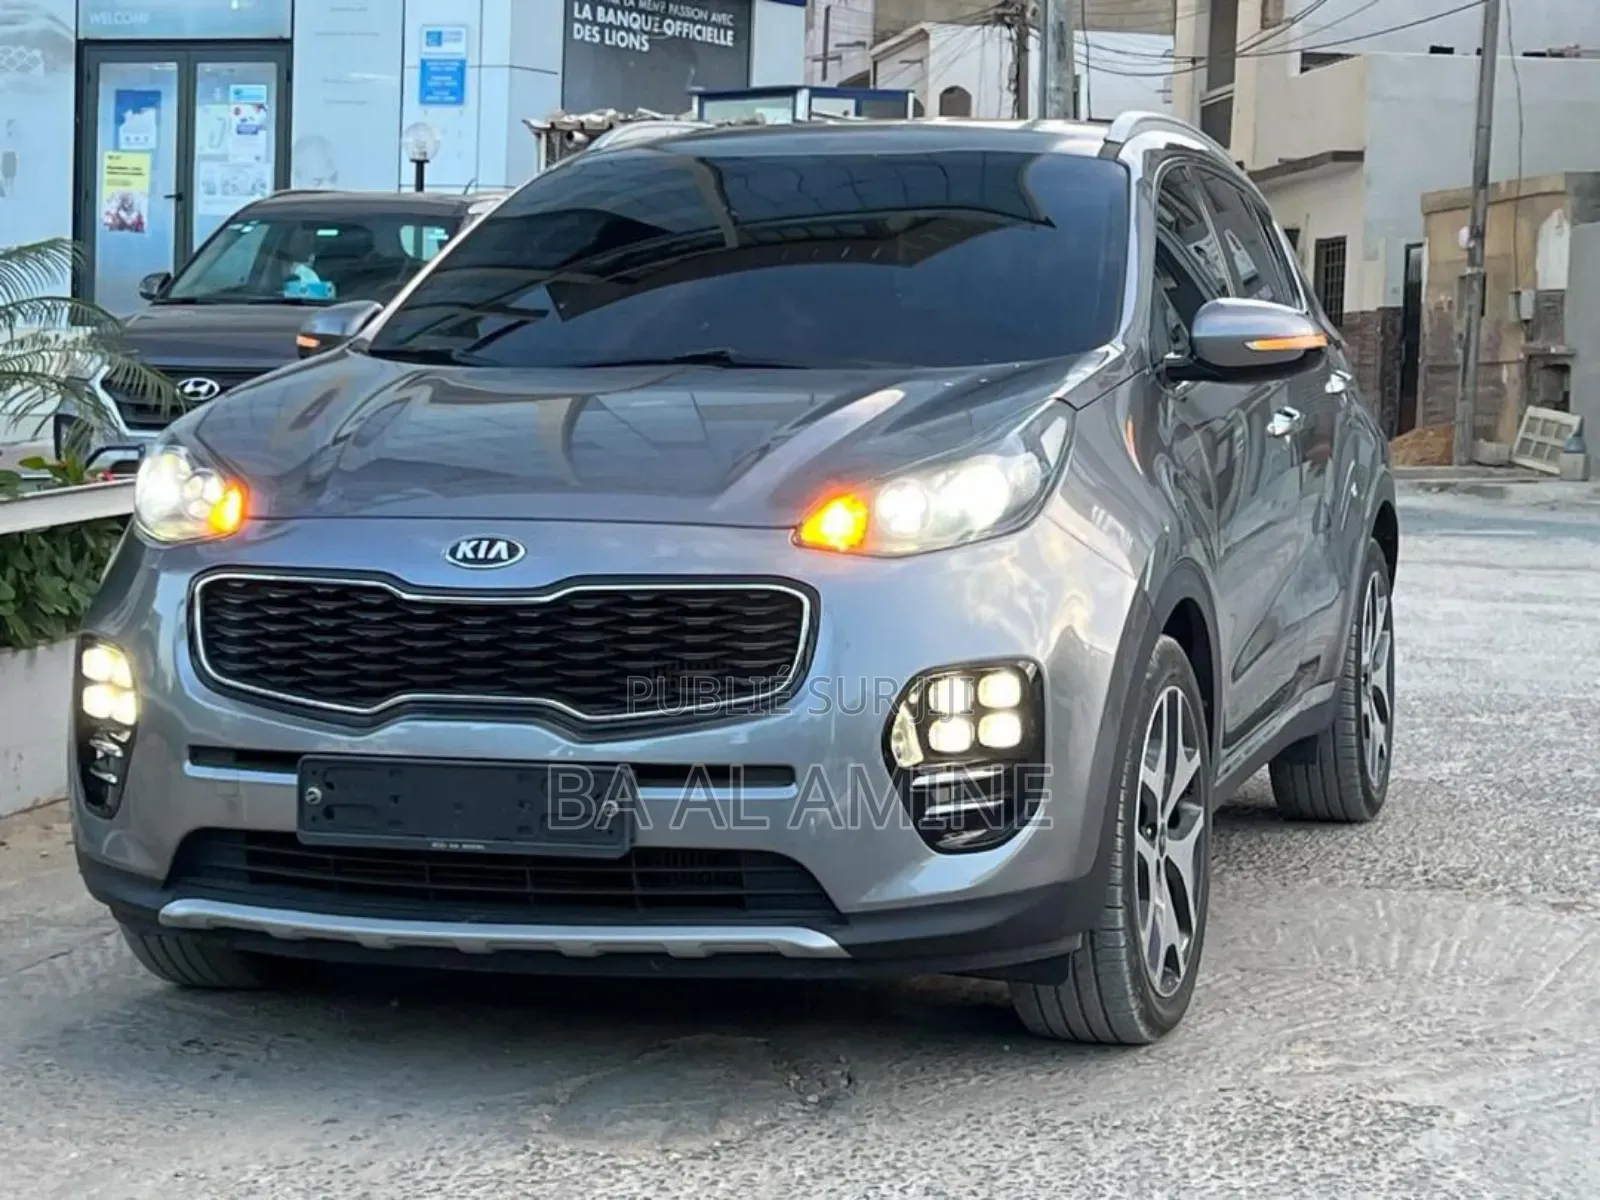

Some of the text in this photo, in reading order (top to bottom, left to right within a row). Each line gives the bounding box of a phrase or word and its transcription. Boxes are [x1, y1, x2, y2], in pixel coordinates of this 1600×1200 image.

[574, 2, 735, 46] LA BANQUE OFFICIELLE
[668, 4, 708, 21] PASSION
[710, 12, 735, 26] AVEC
[573, 23, 650, 52] DES LIONS
[456, 540, 509, 560] KIA
